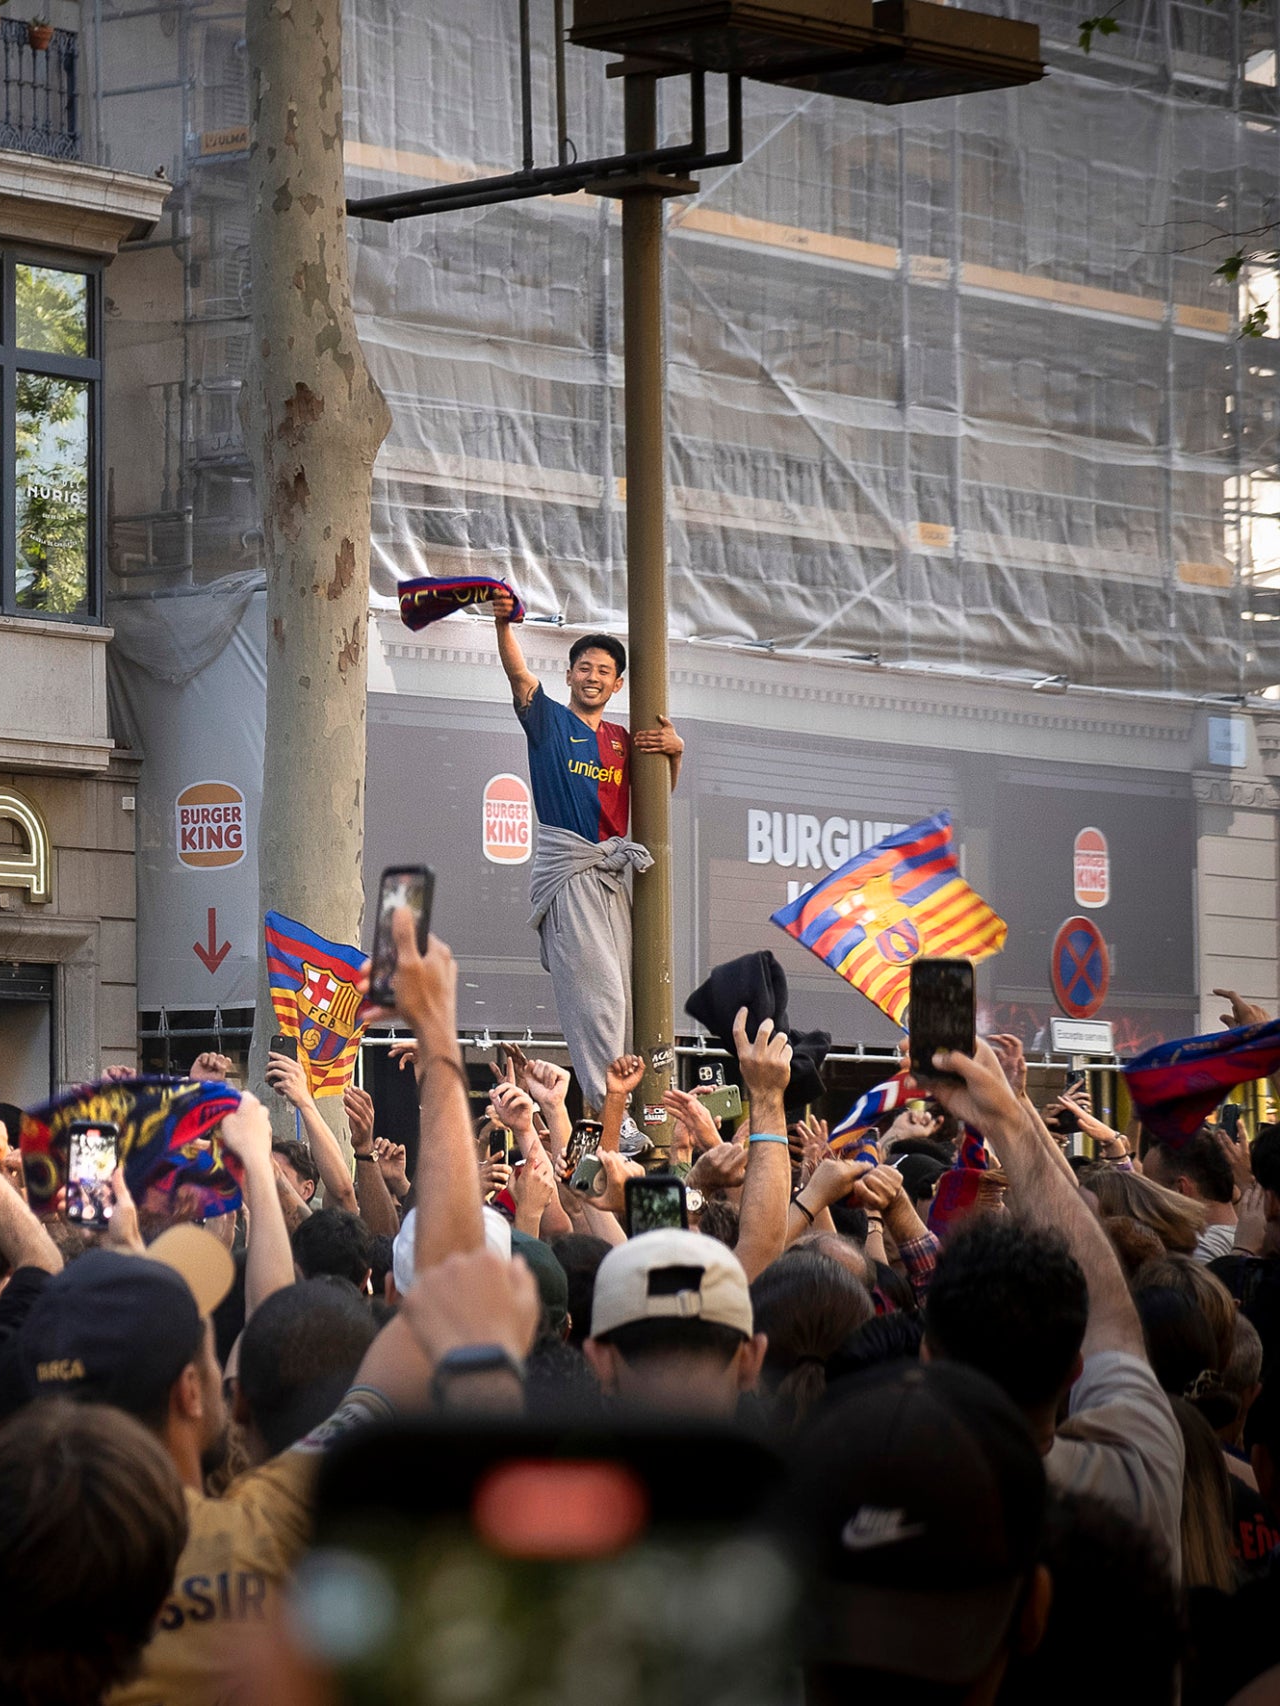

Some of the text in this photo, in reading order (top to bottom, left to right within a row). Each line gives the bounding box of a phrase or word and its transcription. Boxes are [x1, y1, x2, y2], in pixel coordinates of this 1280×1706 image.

[28, 485, 81, 505] NURIA
[568, 759, 615, 784] unicef
[181, 806, 242, 825] BURGER
[485, 802, 529, 820] BURGER
[181, 824, 242, 851] KING
[486, 820, 529, 845] KING
[748, 808, 910, 871] BURGU
[308, 1005, 336, 1029] FCB
